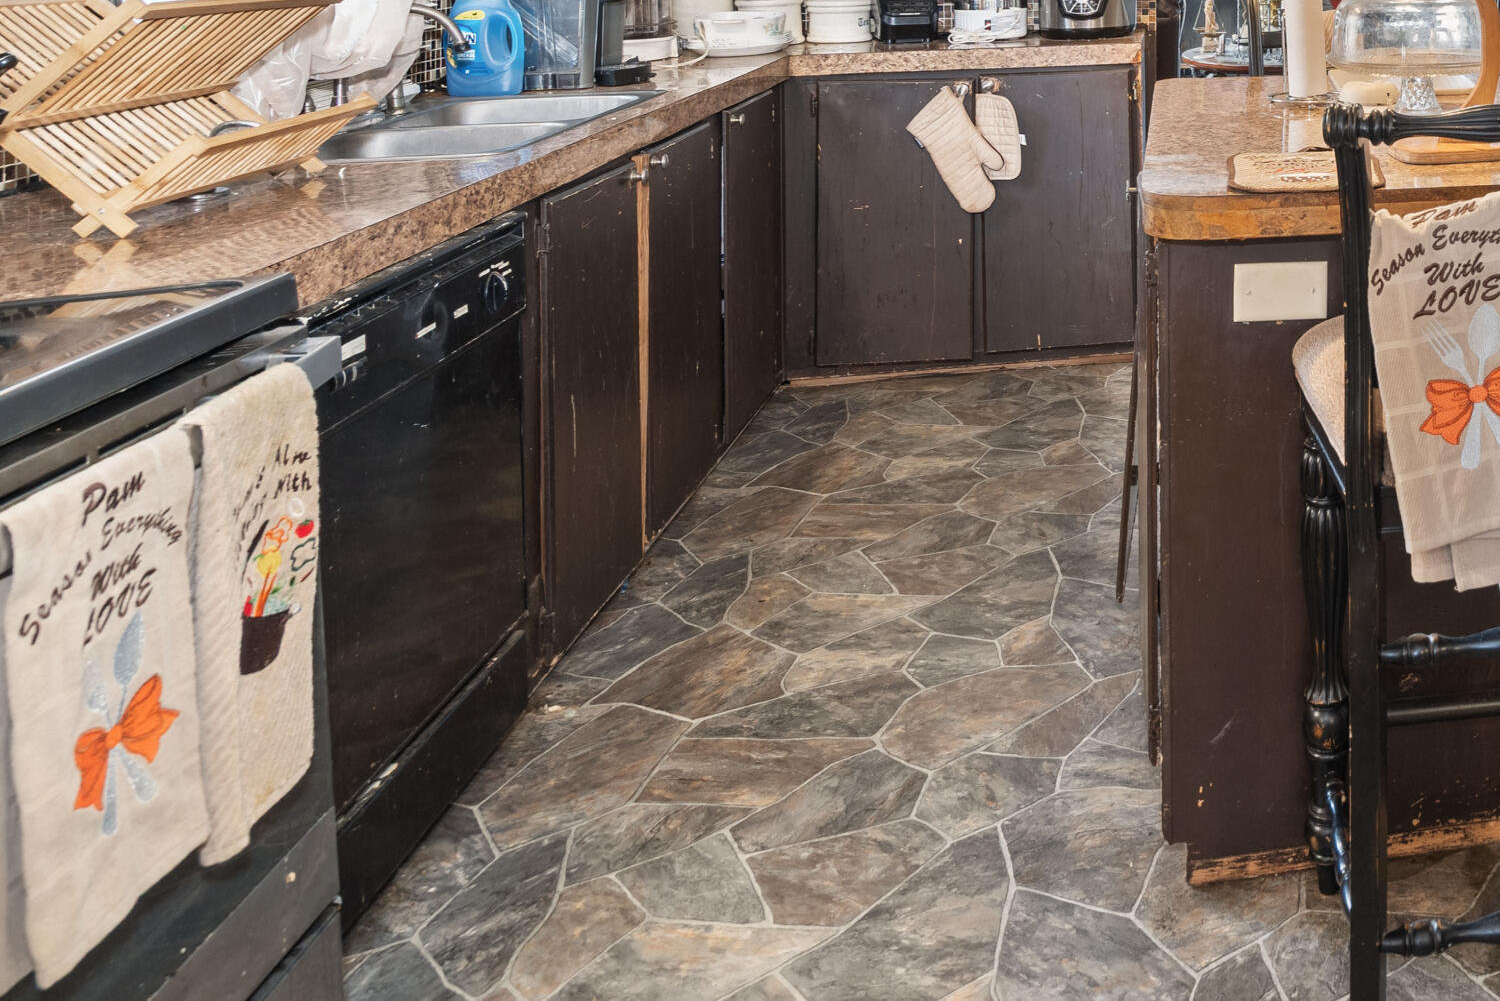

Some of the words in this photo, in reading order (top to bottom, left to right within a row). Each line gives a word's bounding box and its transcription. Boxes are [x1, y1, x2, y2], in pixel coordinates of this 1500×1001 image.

[1410, 200, 1478, 229] Pam
[1370, 242, 1426, 296] Season
[1423, 251, 1485, 286] With
[81, 471, 146, 527] Pam
